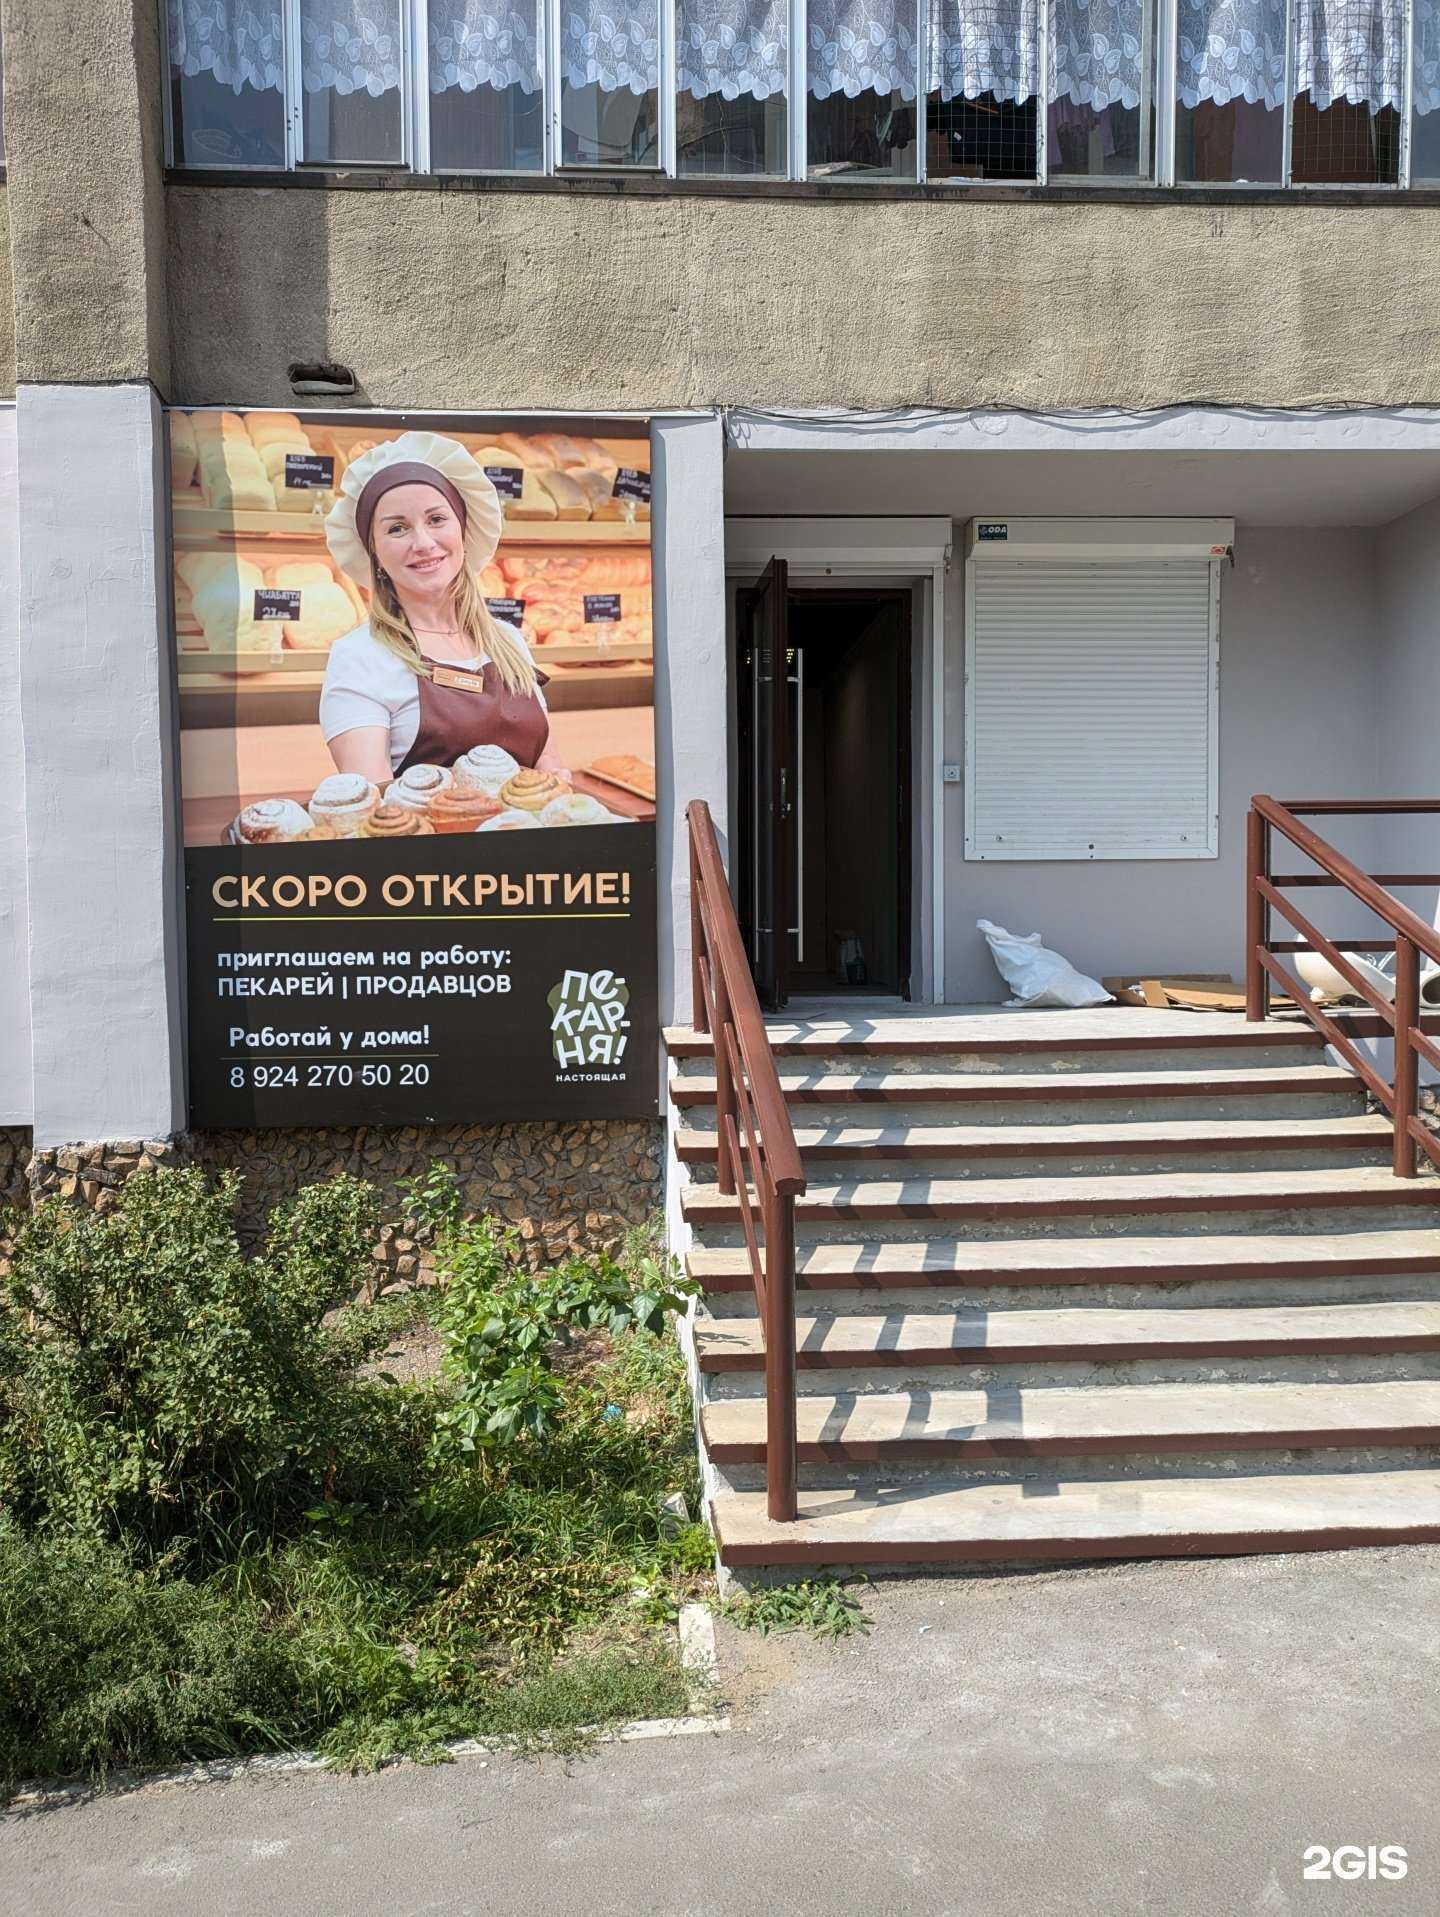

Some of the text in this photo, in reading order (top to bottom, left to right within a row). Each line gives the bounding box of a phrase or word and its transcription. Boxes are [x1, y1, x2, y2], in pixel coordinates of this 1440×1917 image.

[212, 872, 631, 908] СКОРО ОТКРЫТИЕ!
[217, 945, 511, 971] приглашаем на работу:
[218, 971, 334, 997] ПЕКАРЕЙ
[356, 974, 512, 998] ПРОДАВЦОВ
[229, 1025, 430, 1050] Работай у дома!
[555, 1033, 628, 1069] НЯ!
[230, 1064, 430, 1088] 8 924 270 50 20
[556, 1073, 626, 1082] НАСТОЯЩАЯ
